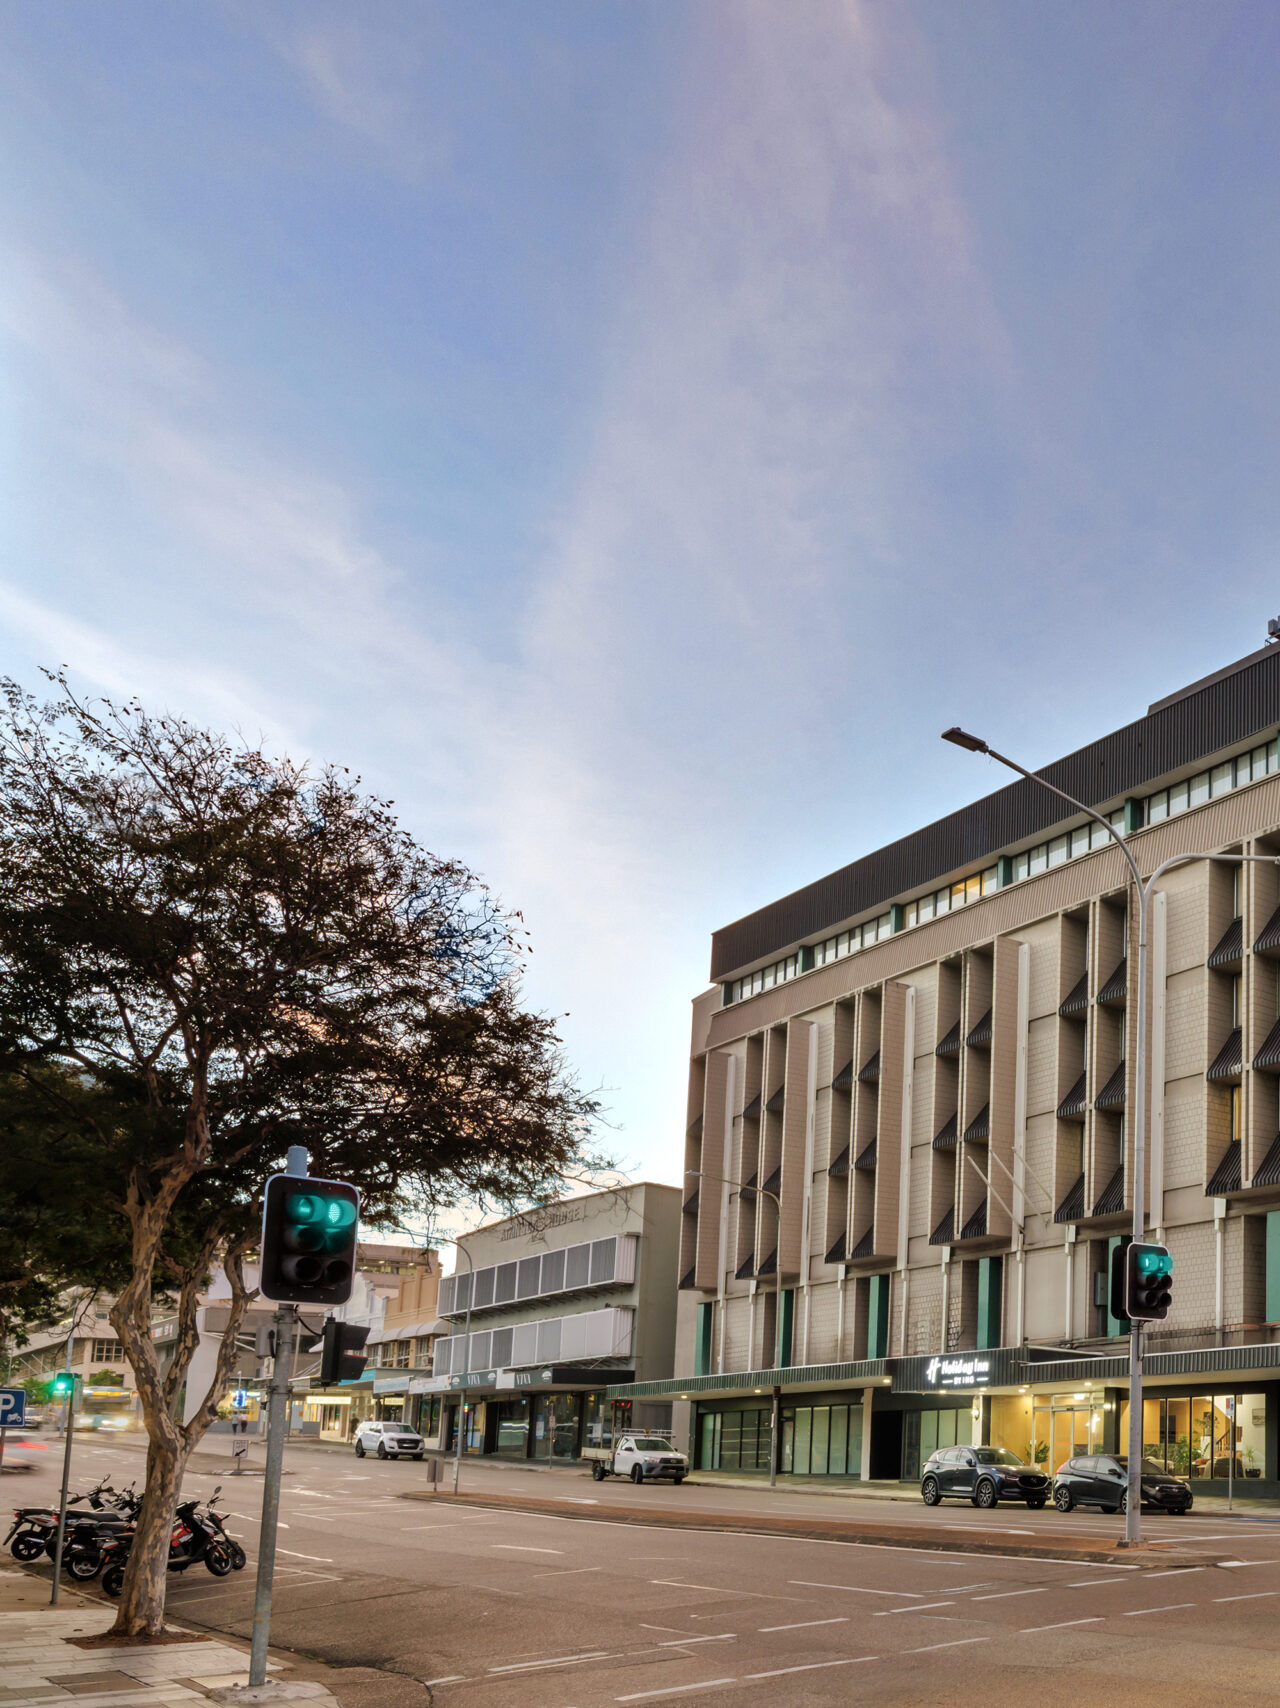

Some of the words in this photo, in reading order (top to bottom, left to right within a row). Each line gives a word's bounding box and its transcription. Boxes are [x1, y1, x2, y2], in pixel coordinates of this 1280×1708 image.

[941, 1359, 974, 1375] Holiday
[974, 1358, 990, 1372] Inn
[953, 1376, 962, 1385] BY
[962, 1375, 975, 1384] IHG
[0, 1393, 15, 1420] P
